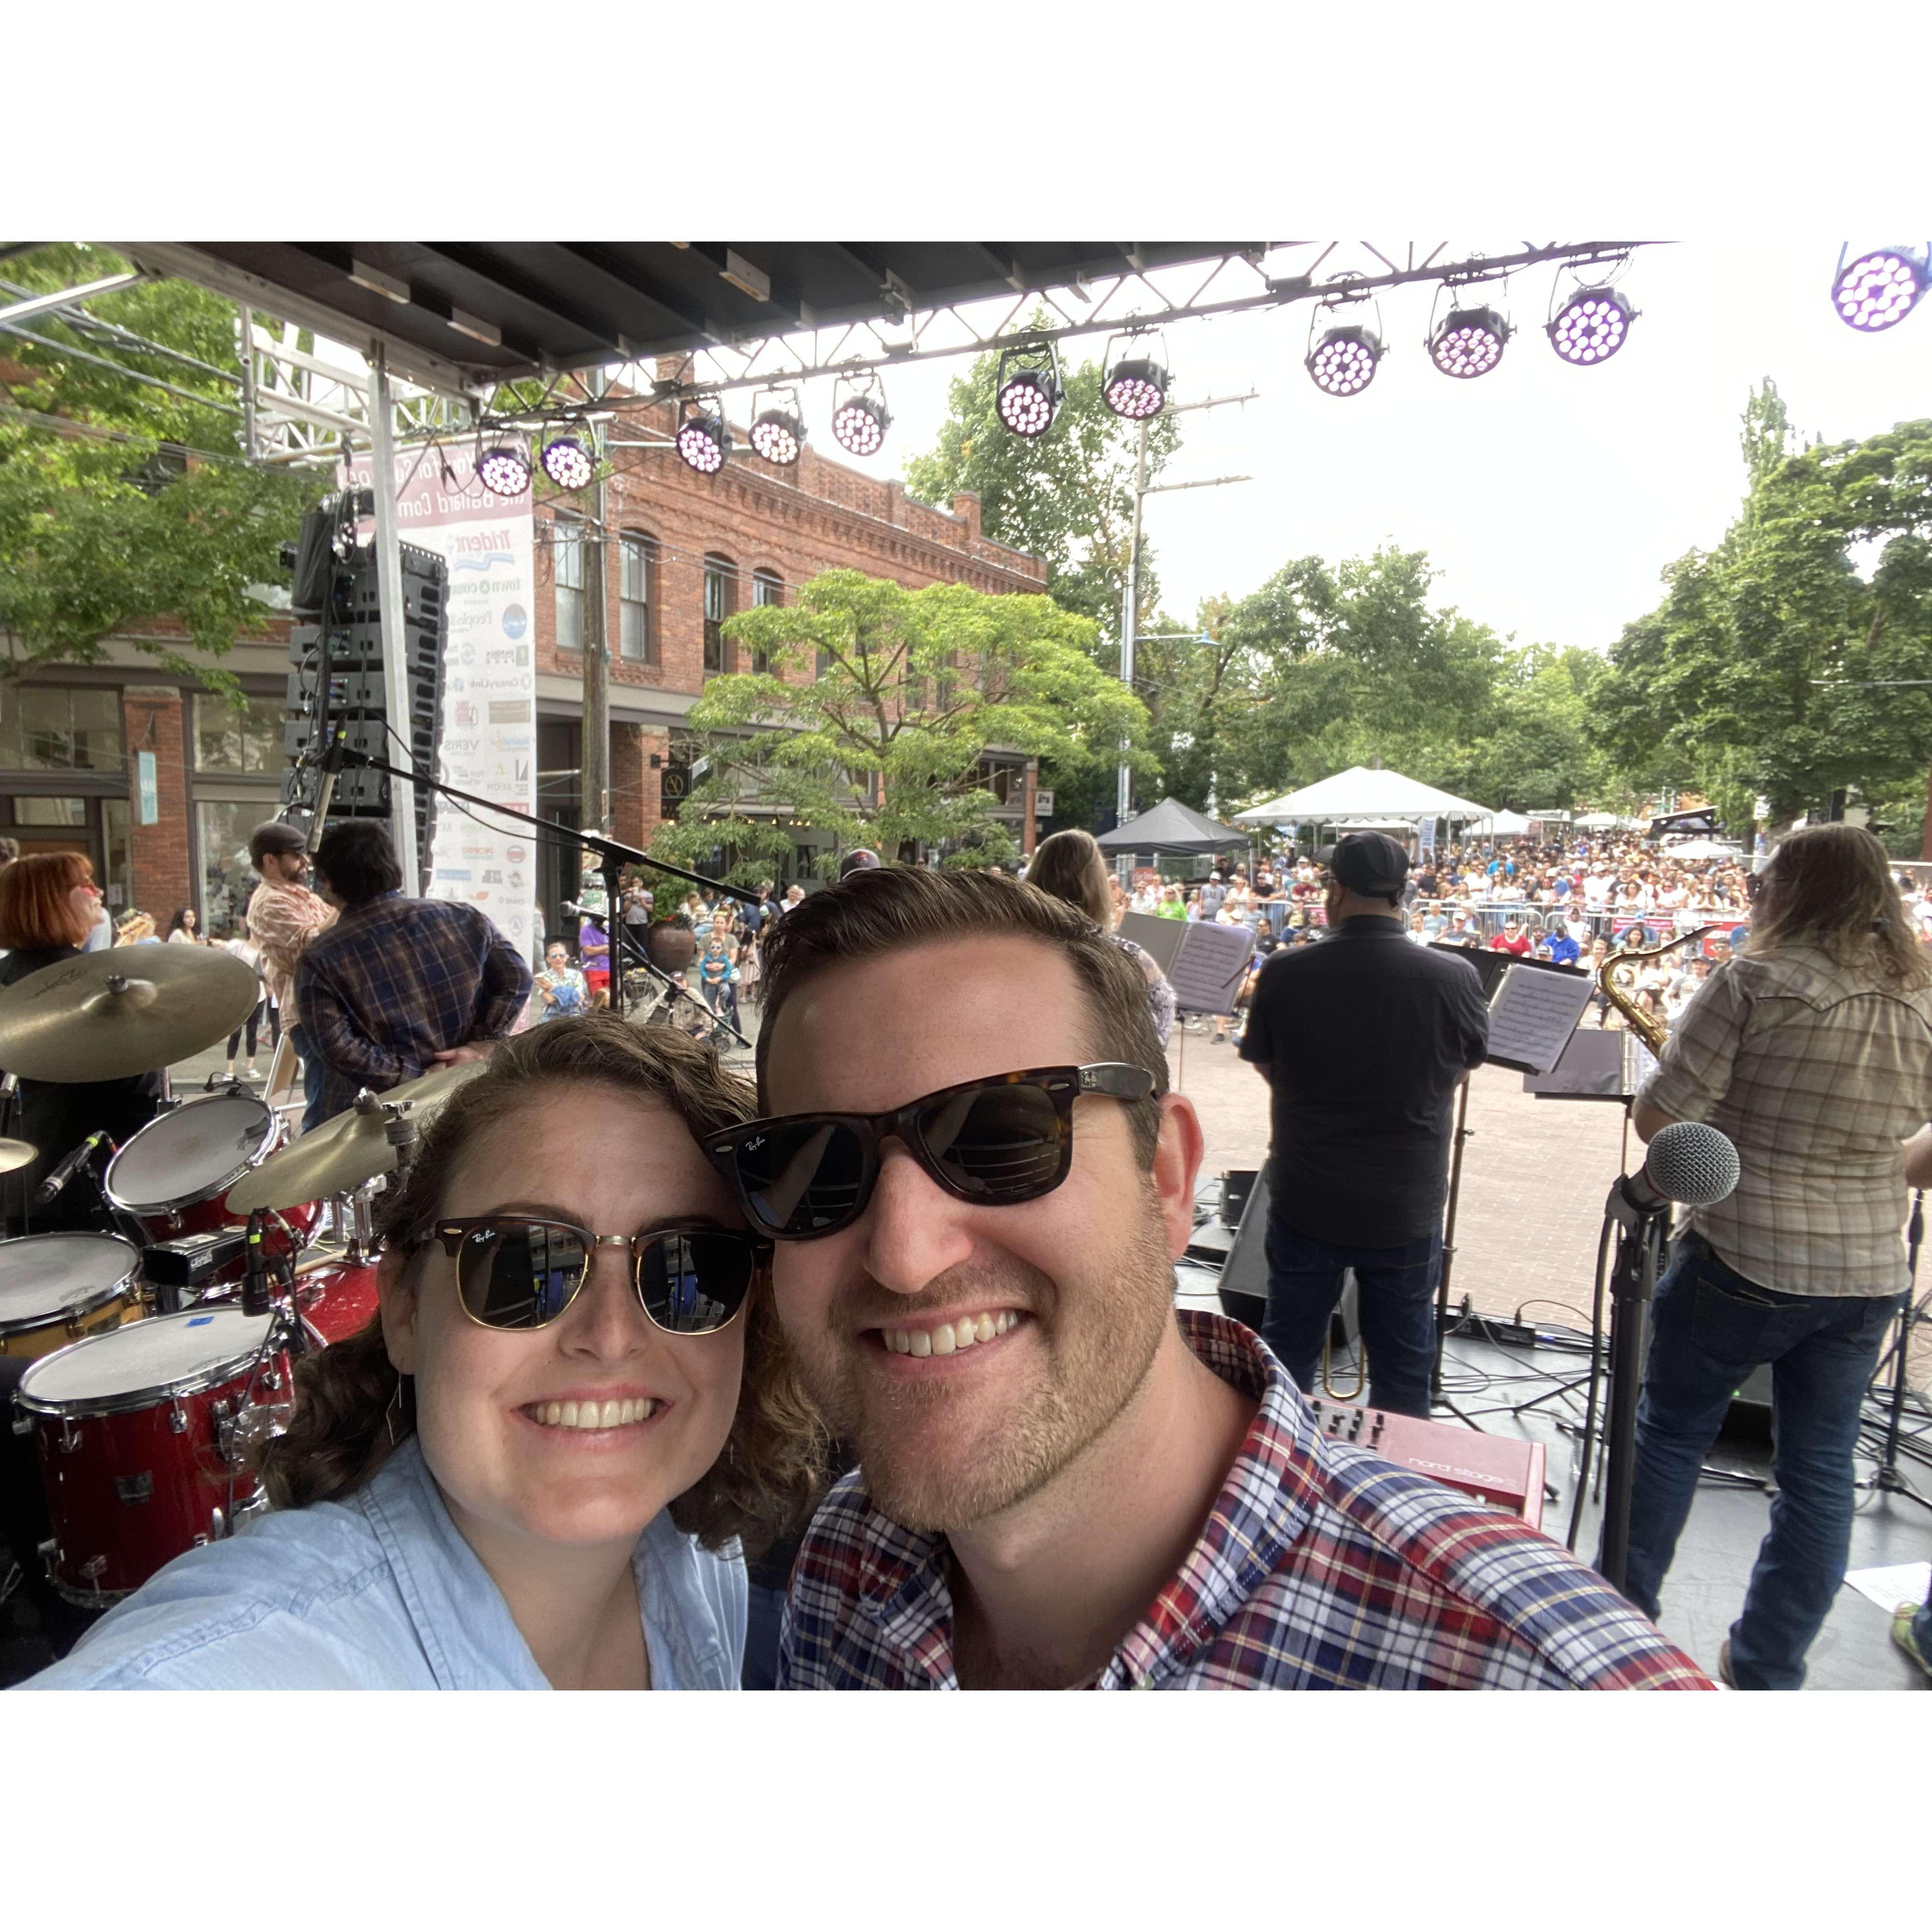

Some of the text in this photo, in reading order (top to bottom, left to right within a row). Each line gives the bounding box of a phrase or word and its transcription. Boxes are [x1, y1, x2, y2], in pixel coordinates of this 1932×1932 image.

[745, 1136, 766, 1151] Ray-Ban
[472, 1230, 495, 1243] Ray-Ban
[1453, 1467, 1504, 1484] stage
